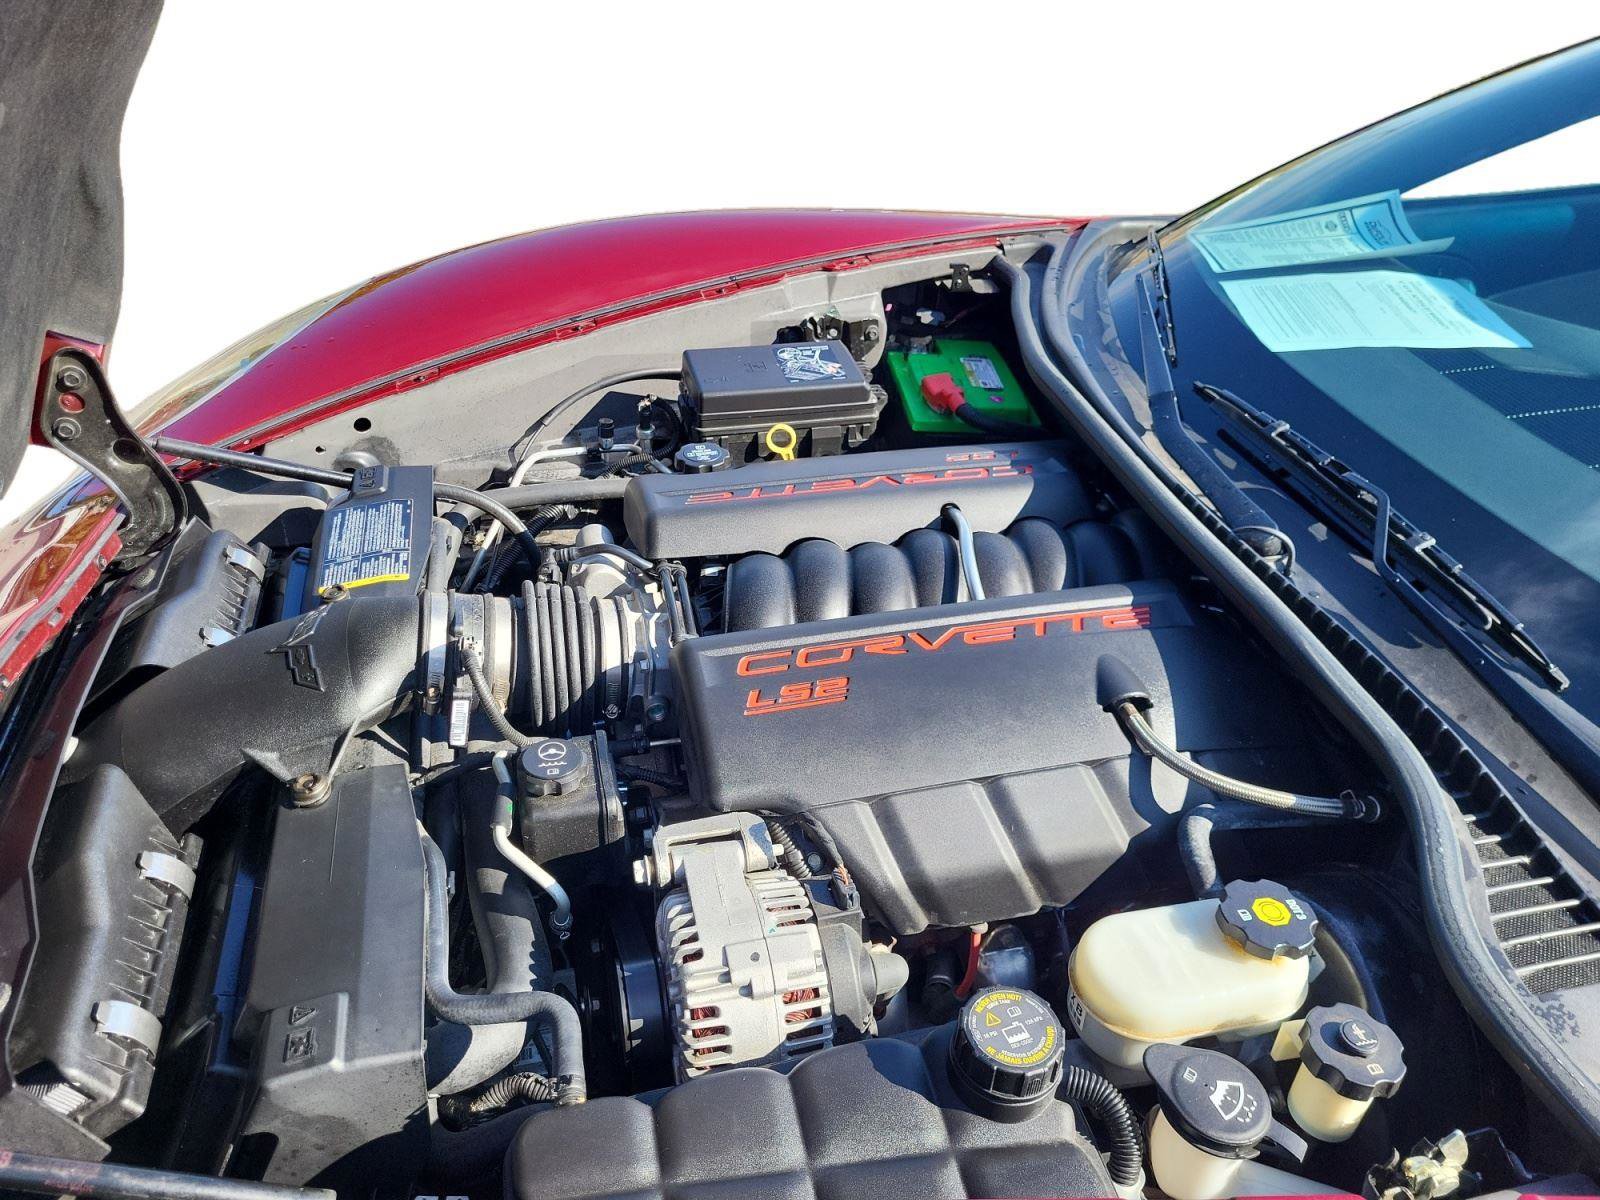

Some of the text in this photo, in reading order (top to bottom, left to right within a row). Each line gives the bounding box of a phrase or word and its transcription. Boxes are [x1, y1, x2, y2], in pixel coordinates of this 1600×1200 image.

[737, 606, 1151, 677] CORVETTE
[746, 676, 850, 710] LS2
[989, 993, 1006, 1001] OPEN
